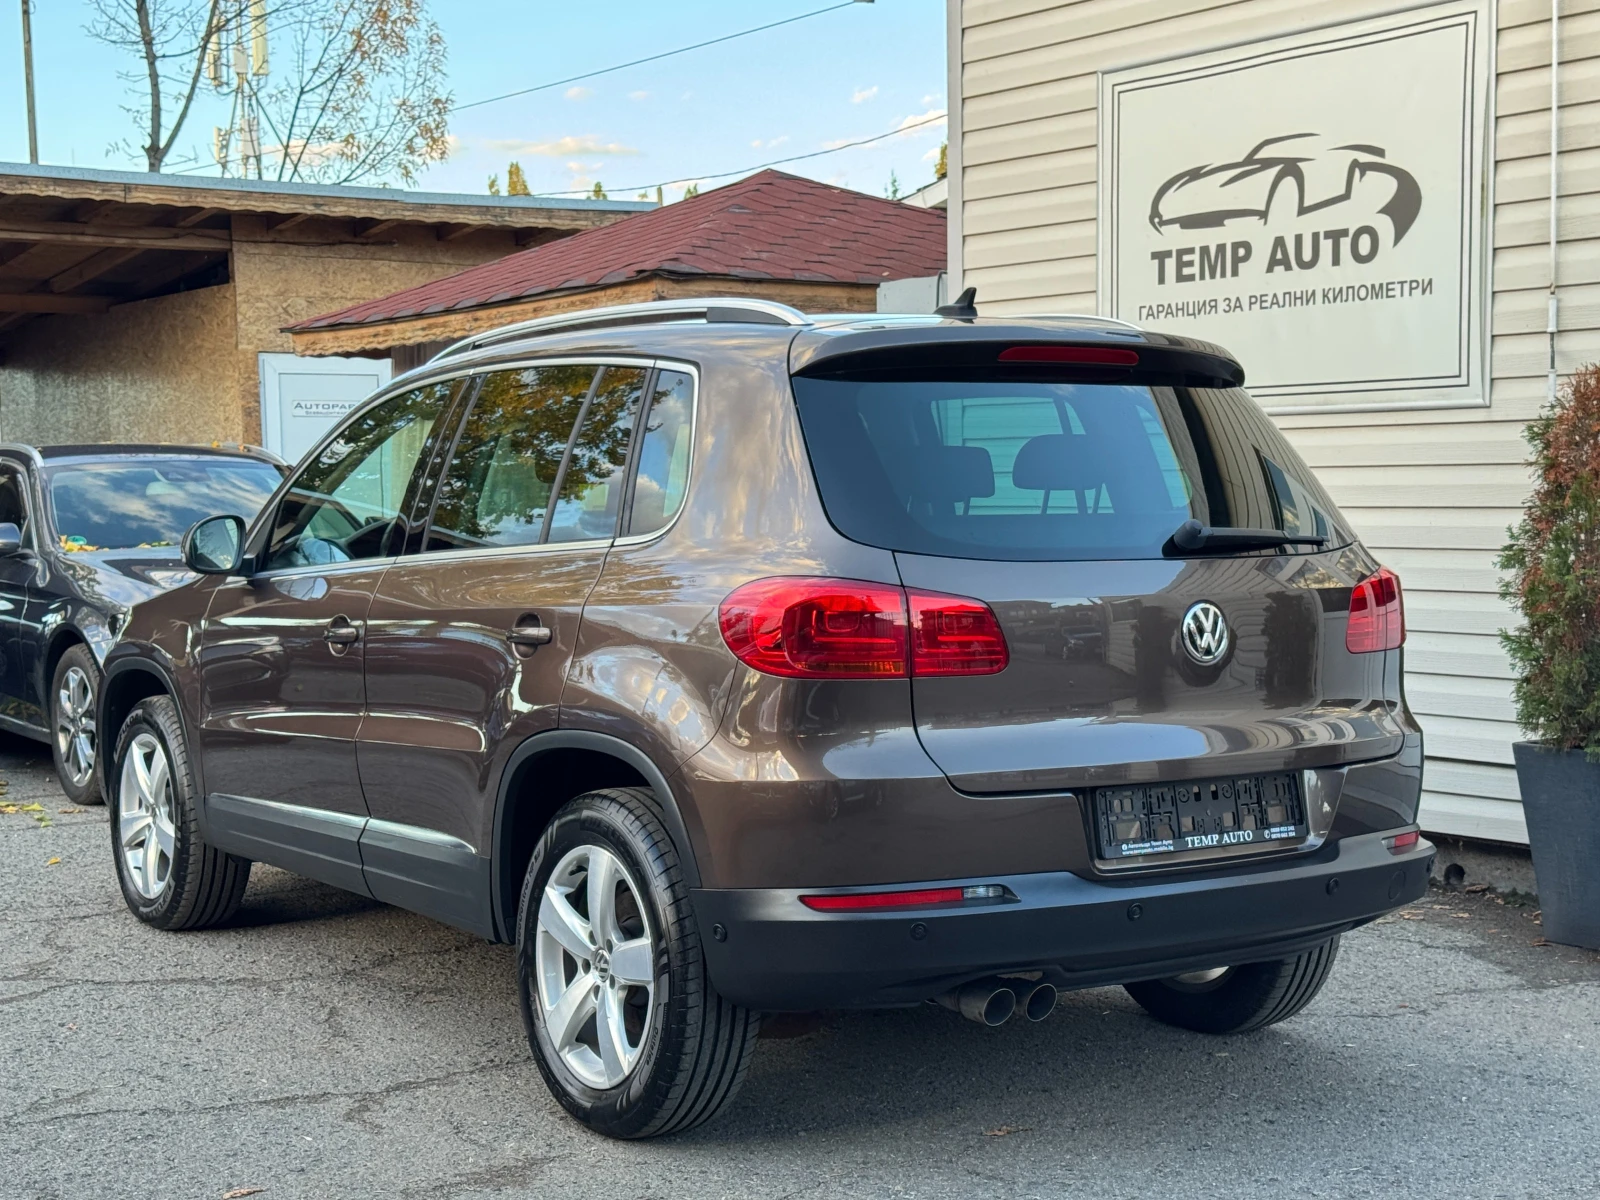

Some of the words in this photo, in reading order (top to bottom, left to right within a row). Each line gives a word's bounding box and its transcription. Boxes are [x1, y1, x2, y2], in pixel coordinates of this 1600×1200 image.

[1150, 240, 1253, 286] TEMP
[1265, 224, 1380, 274] AUTO
[1138, 298, 1218, 321] ГАРАНЦИЯ
[1222, 296, 1244, 314] ЗА
[1248, 289, 1316, 311] РЕАЛНИ
[1322, 277, 1433, 305] КИЛОМЕТРИ
[1185, 835, 1219, 848] TEMP
[1222, 830, 1253, 844] AUTO
